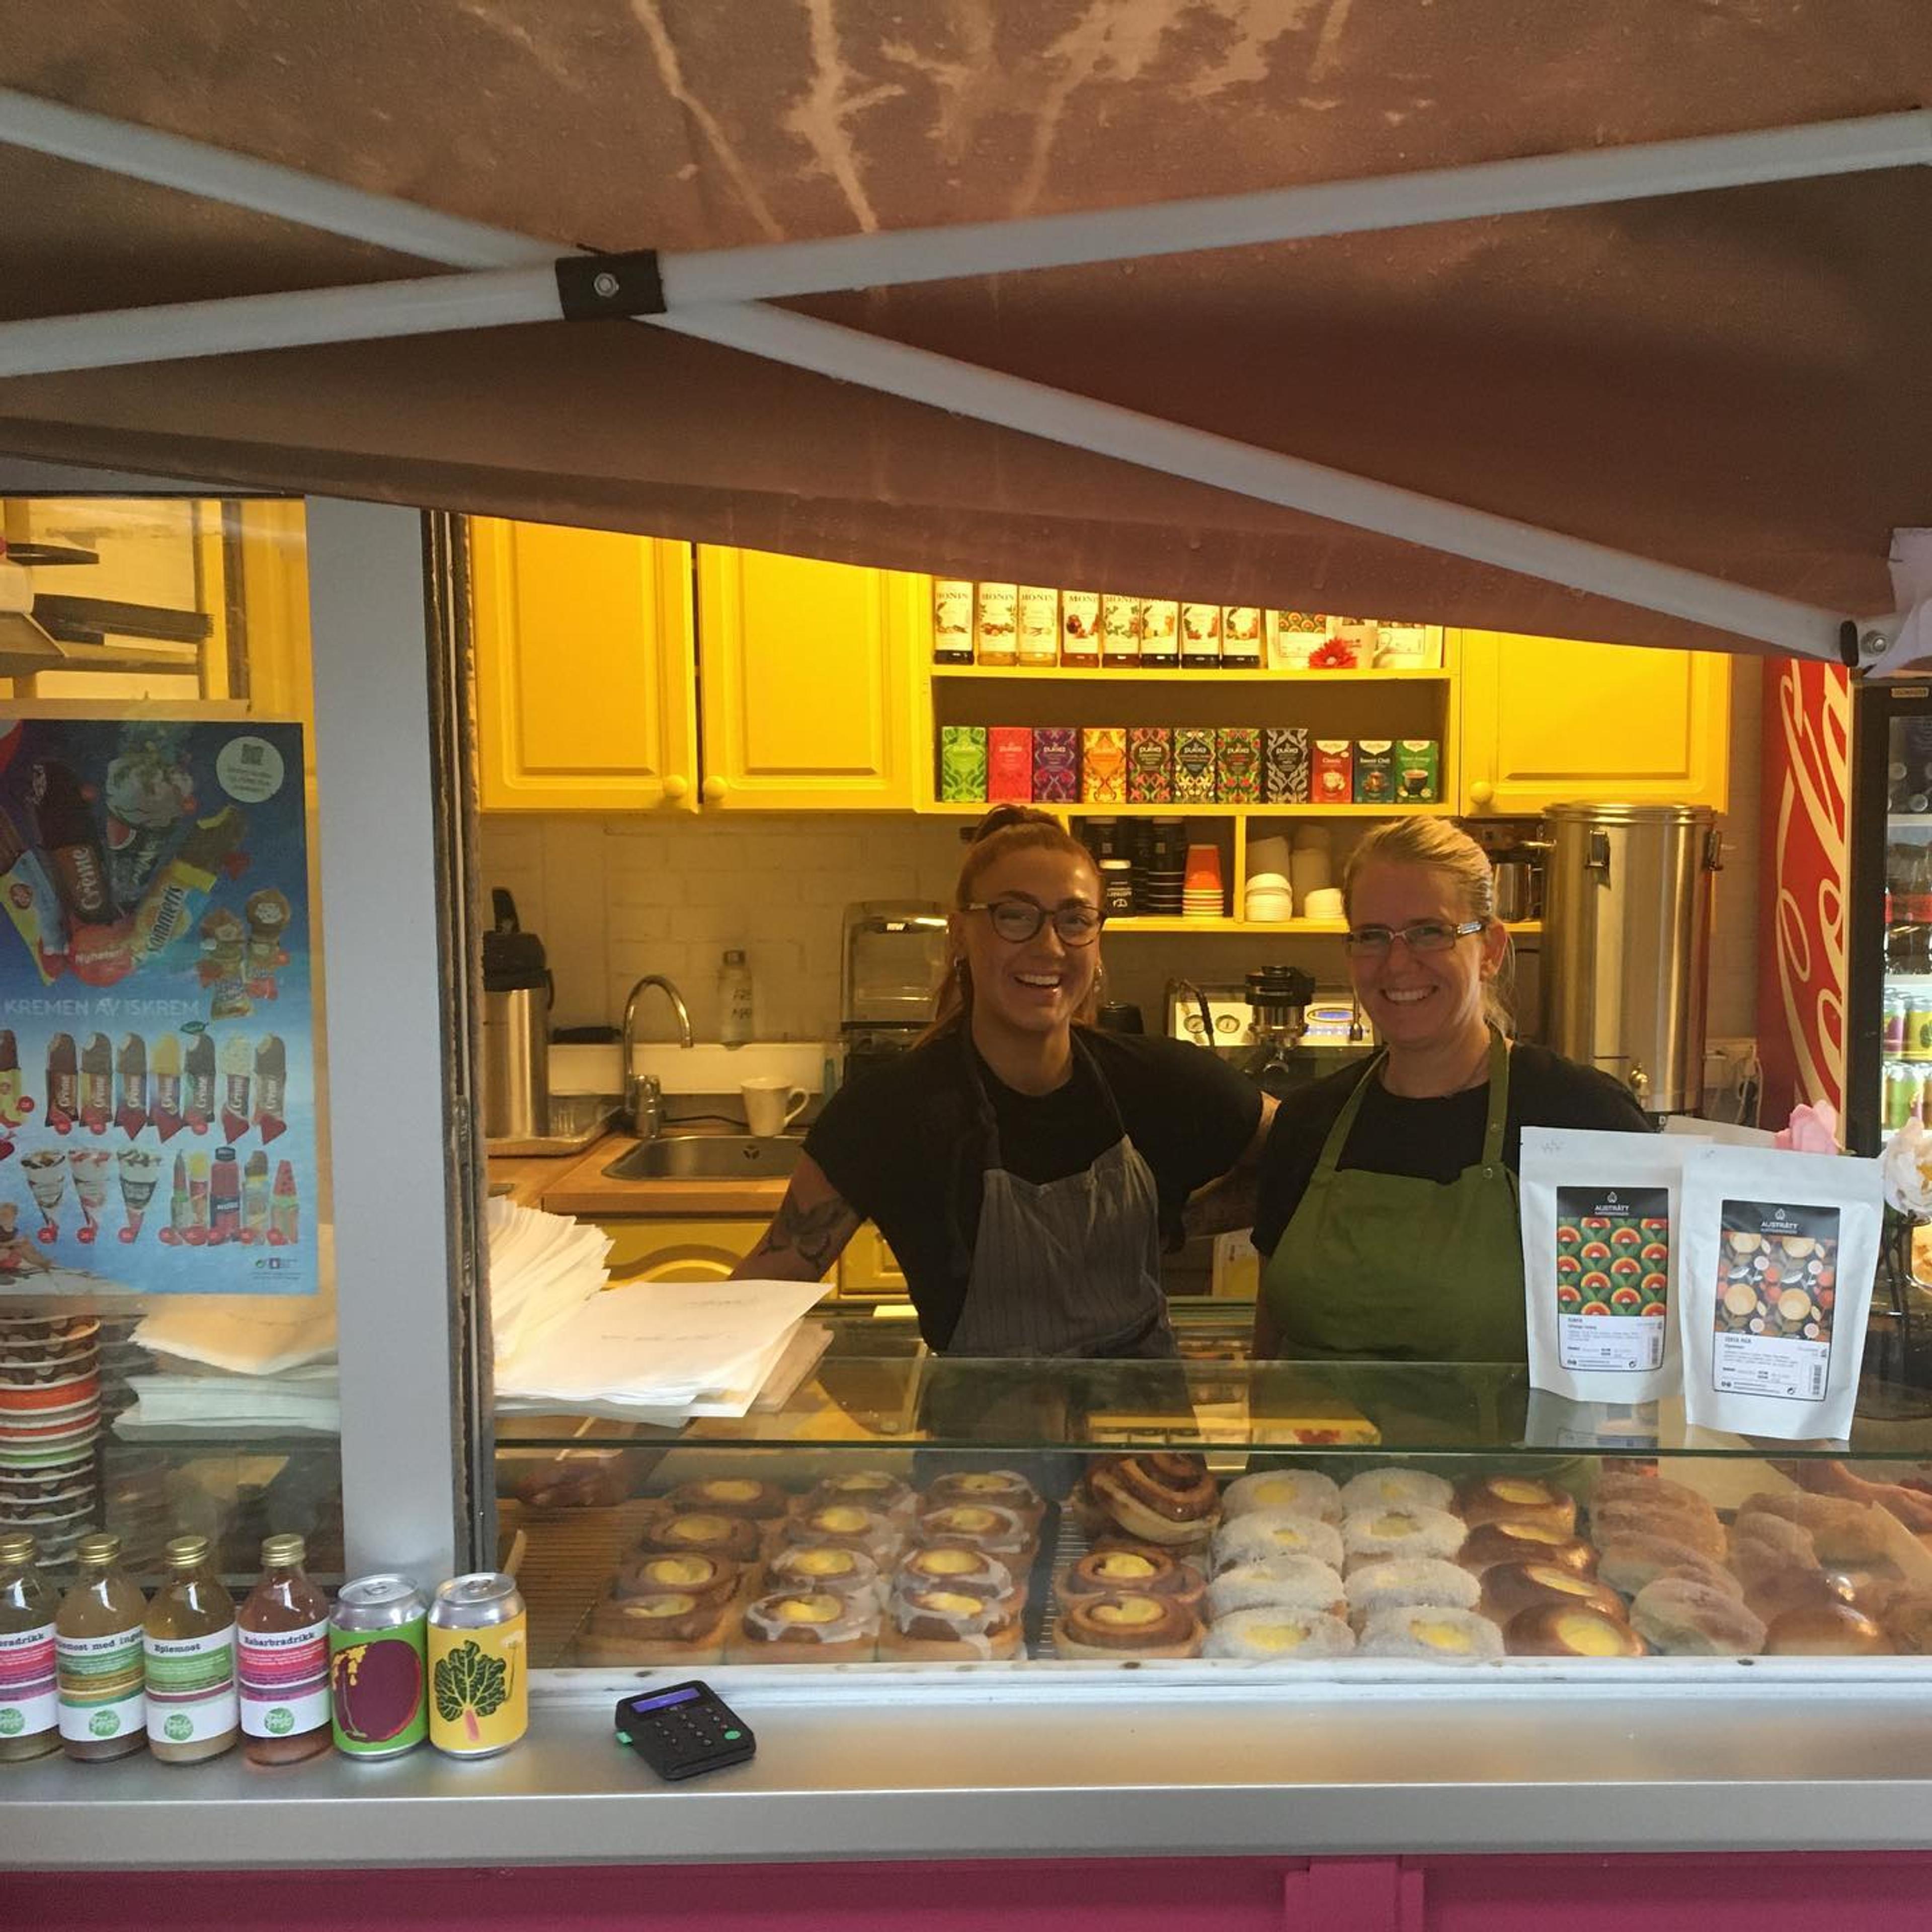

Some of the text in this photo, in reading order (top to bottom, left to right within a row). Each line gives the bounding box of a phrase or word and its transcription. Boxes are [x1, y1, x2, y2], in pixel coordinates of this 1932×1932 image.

[5, 999, 88, 1016] KREMEN
[127, 999, 200, 1016] ISKREM
[93, 1640, 115, 1650] med
[244, 1632, 314, 1646] Rabarbradrikk
[154, 1644, 201, 1653] Eplemost
